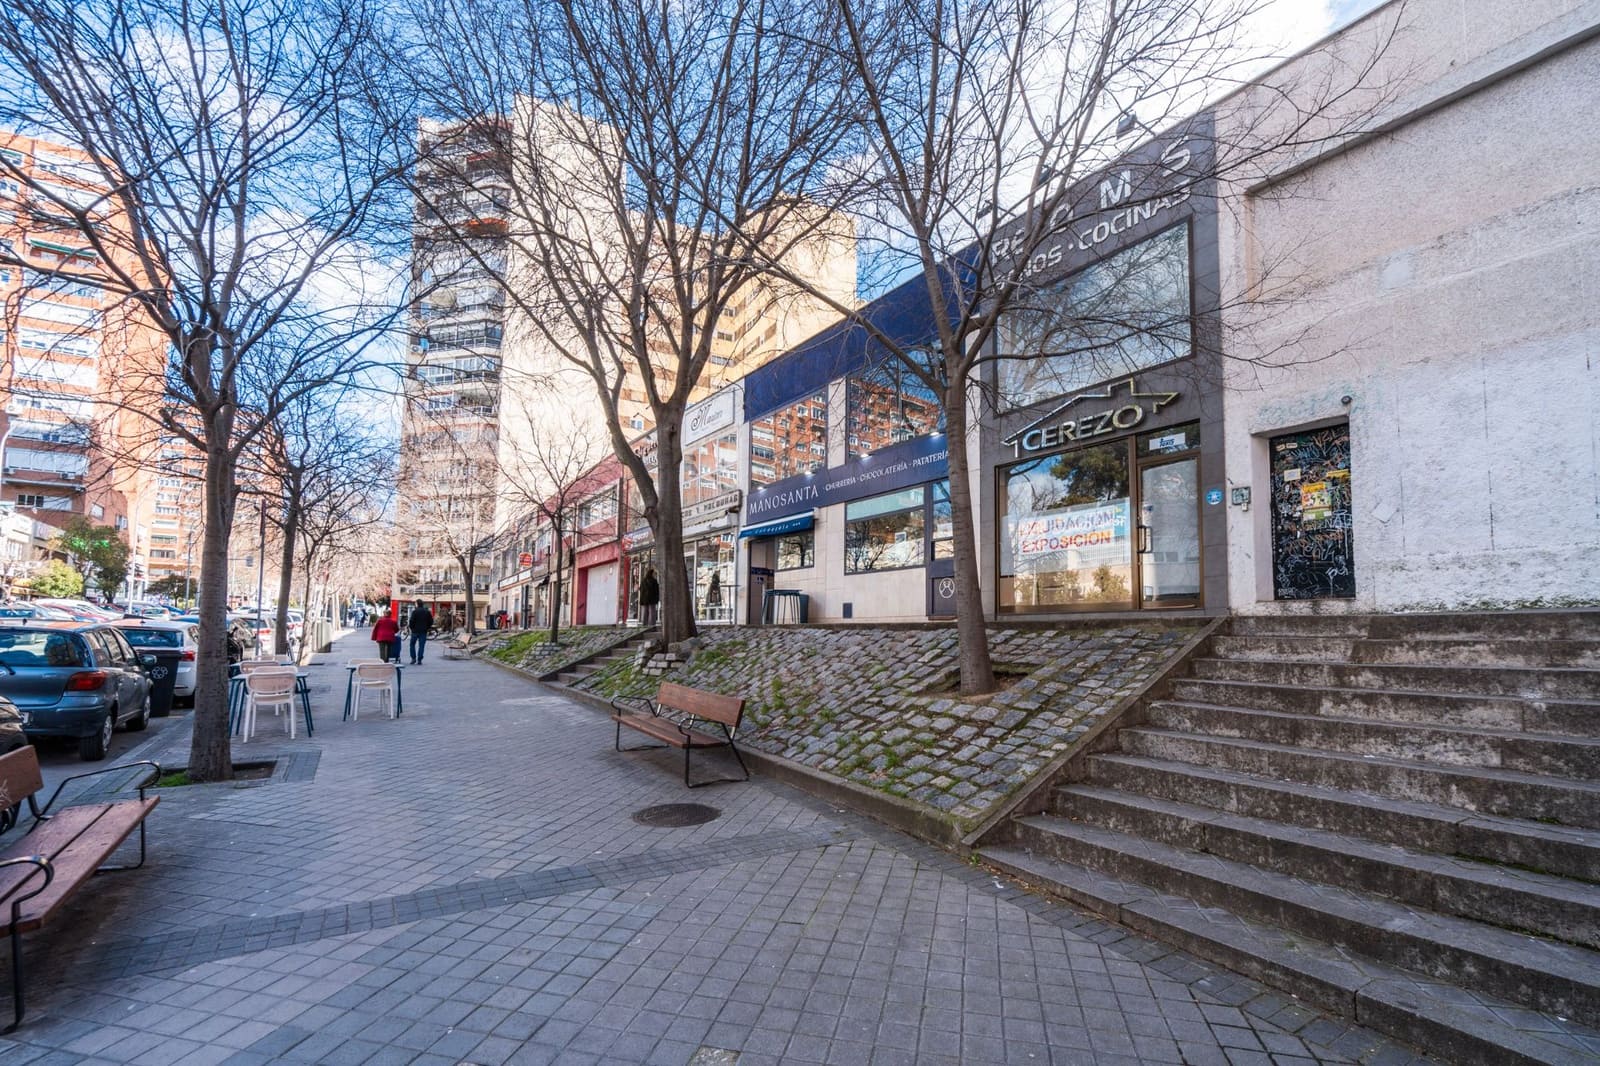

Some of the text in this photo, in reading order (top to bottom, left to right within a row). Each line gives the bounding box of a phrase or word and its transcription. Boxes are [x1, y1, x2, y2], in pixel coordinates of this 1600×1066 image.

[1078, 179, 1191, 250] COCINAS
[1022, 404, 1143, 451] CEREZO
[750, 484, 820, 515] MANOSANTA
[860, 462, 908, 482] CHOCOLATERÍA
[1022, 529, 1111, 553] EXPOSICIÓN
